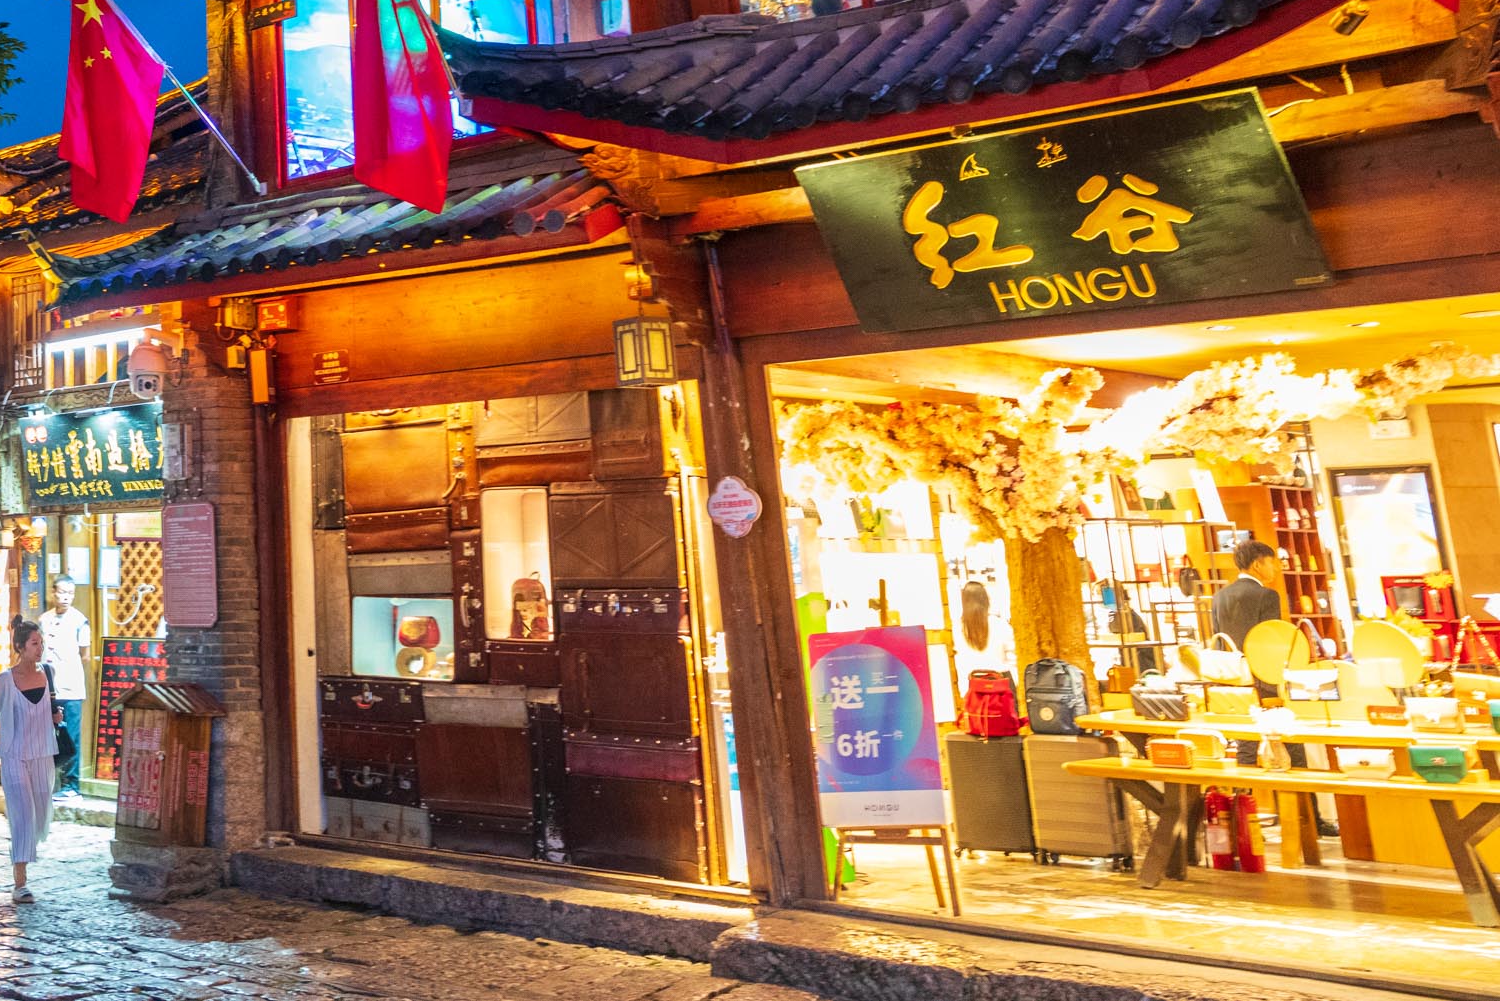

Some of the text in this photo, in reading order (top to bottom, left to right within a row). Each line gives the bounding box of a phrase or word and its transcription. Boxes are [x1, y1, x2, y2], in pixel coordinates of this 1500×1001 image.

[903, 173, 1193, 290] 红谷
[988, 262, 1158, 314] HONGU
[830, 674, 900, 711] 送一
[870, 671, 899, 685] 买一
[836, 729, 882, 759] 6折
